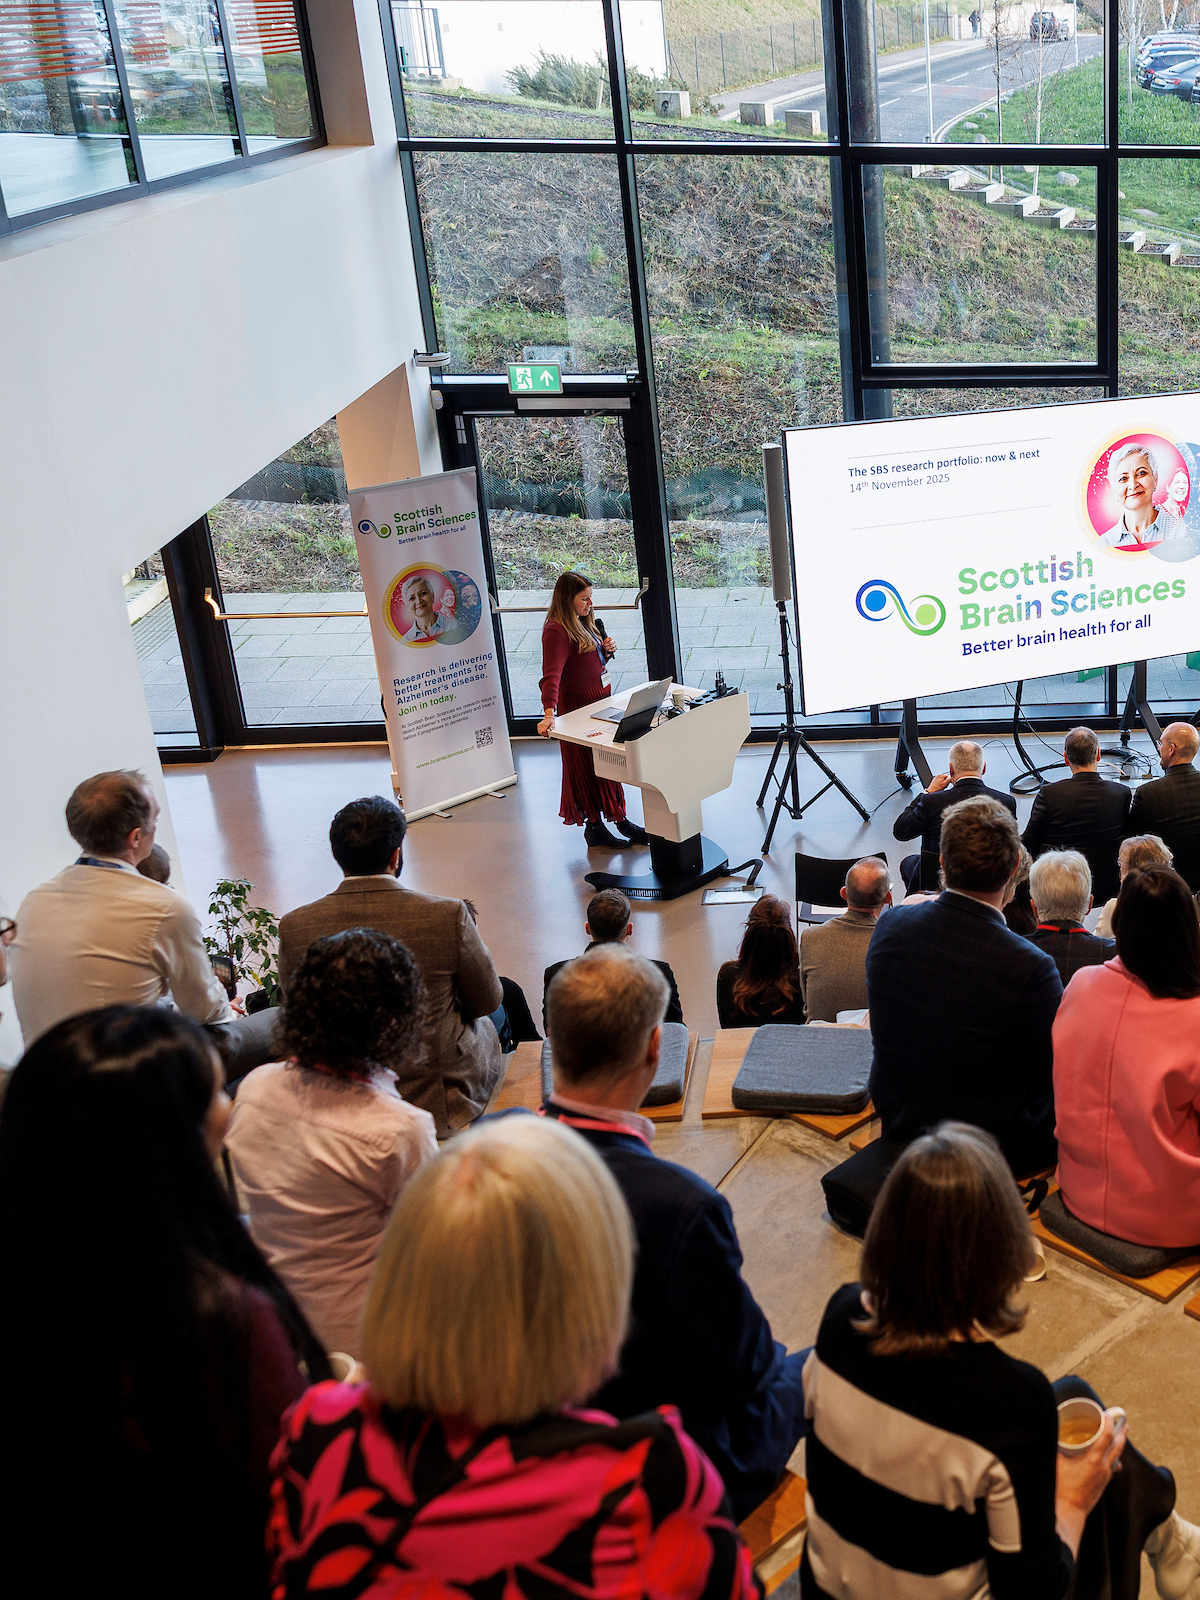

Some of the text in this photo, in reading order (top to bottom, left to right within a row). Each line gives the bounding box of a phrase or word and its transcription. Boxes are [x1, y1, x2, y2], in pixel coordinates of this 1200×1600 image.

[848, 449, 1040, 477] The SBS research portfolio: now & next
[850, 473, 950, 492] 14th November 2025
[394, 504, 442, 522] Scottish
[396, 511, 476, 535] Brain Sciences
[399, 537, 416, 545] Better
[432, 529, 450, 537] health
[958, 551, 1093, 595] Scottish
[960, 579, 1186, 630] Brain Sciences
[962, 614, 1151, 656] Better brain health for all
[393, 668, 436, 687] Research
[449, 652, 492, 670] delivering
[395, 663, 487, 696] better treatments for
[397, 673, 488, 705] Alzheimer's disease.
[398, 705, 417, 716] Join
[430, 693, 457, 706] today.
